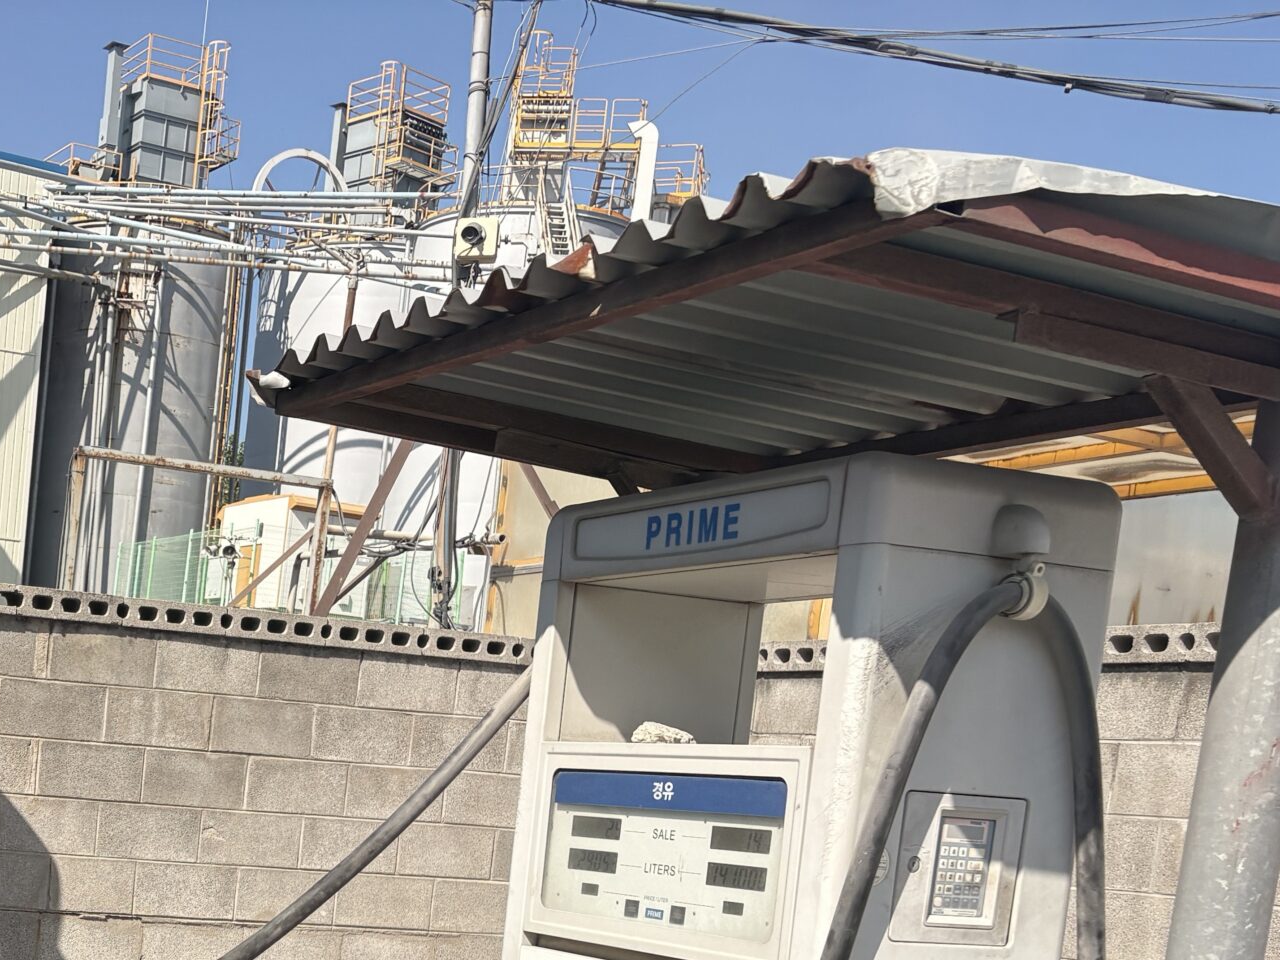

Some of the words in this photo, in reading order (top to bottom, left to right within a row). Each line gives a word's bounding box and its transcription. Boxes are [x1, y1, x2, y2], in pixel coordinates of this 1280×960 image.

[645, 503, 740, 550] PRIME
[652, 781, 674, 801] 경유
[652, 828, 676, 841] SALE
[644, 862, 676, 876] LITERS
